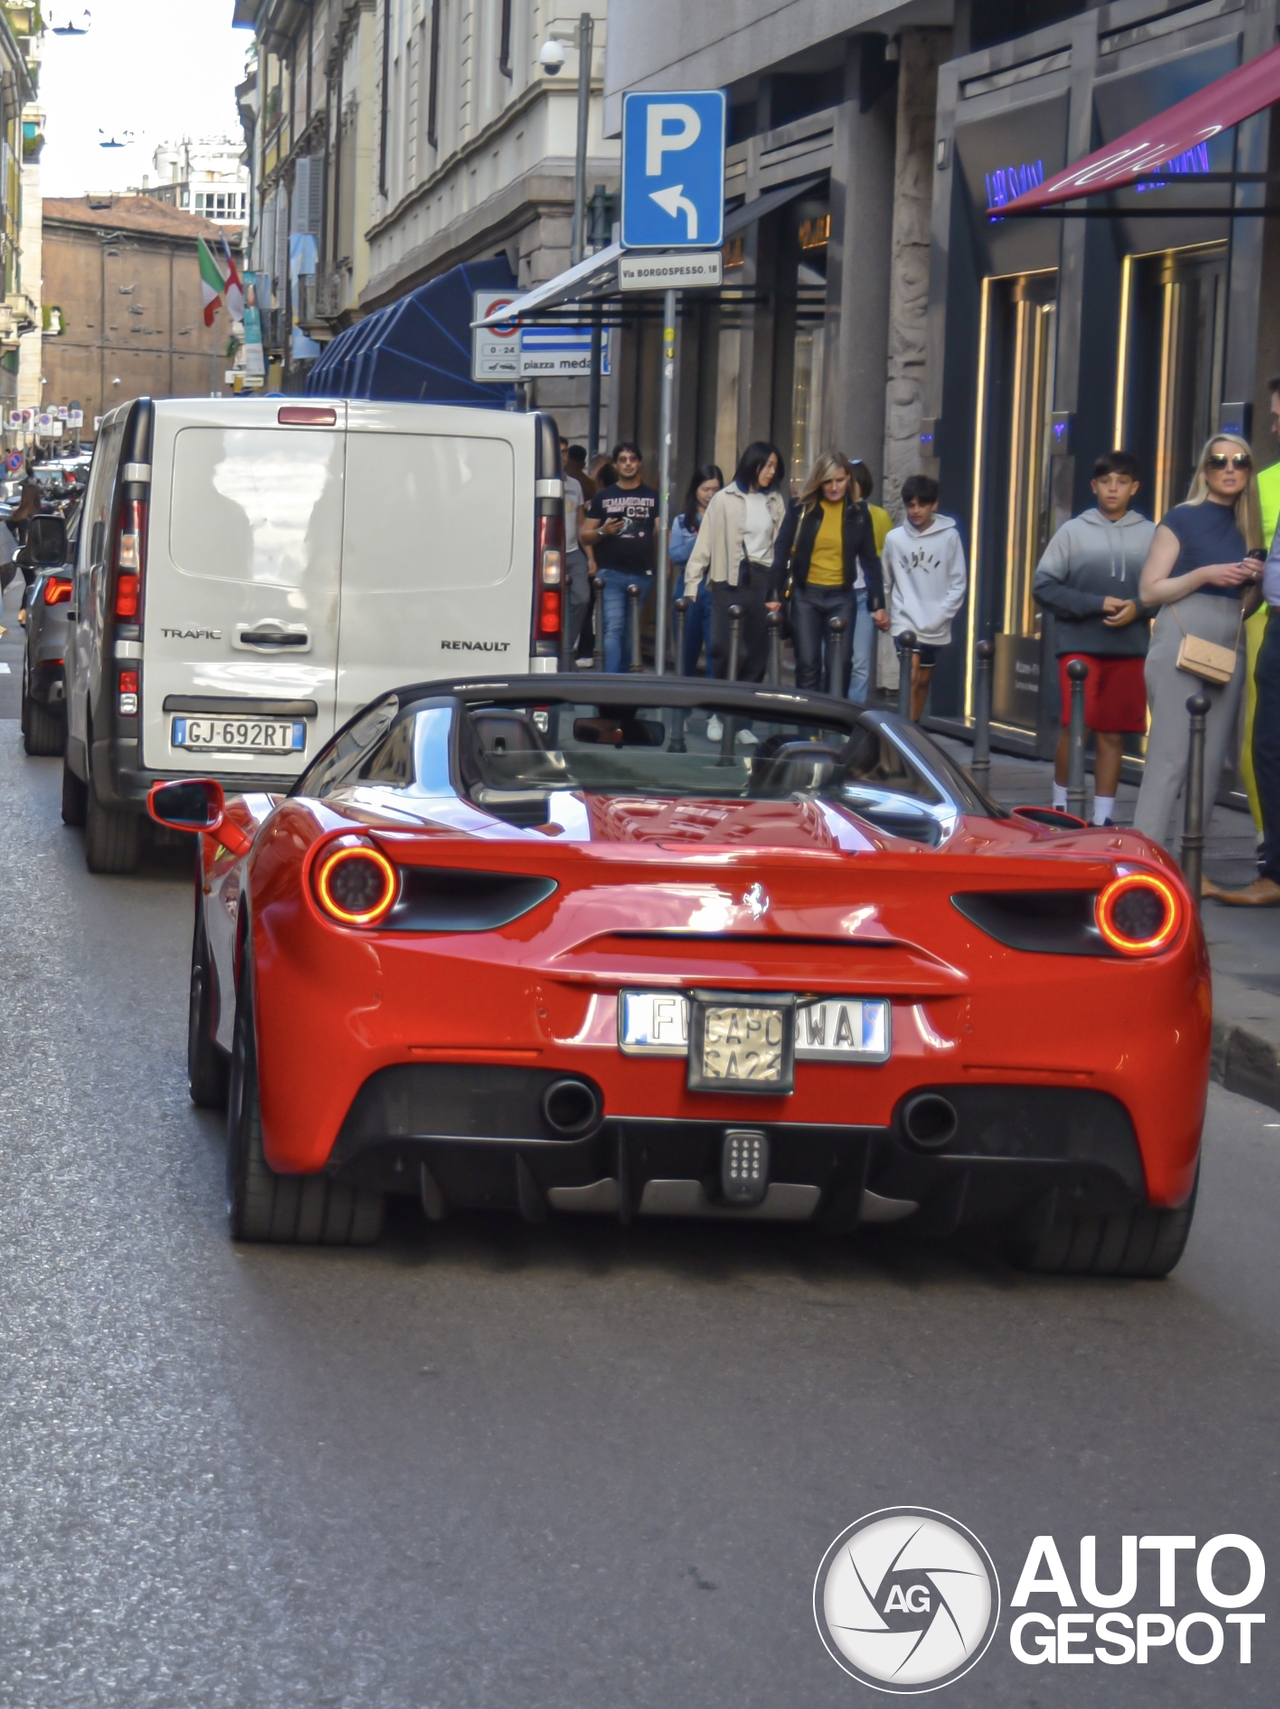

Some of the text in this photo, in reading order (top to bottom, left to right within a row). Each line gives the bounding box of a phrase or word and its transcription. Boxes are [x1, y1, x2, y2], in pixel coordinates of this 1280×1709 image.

[646, 103, 702, 176] P
[623, 270, 635, 278] Via
[523, 360, 555, 371] piazza
[160, 628, 222, 640] TRAFIC
[441, 640, 511, 651] RENAULT
